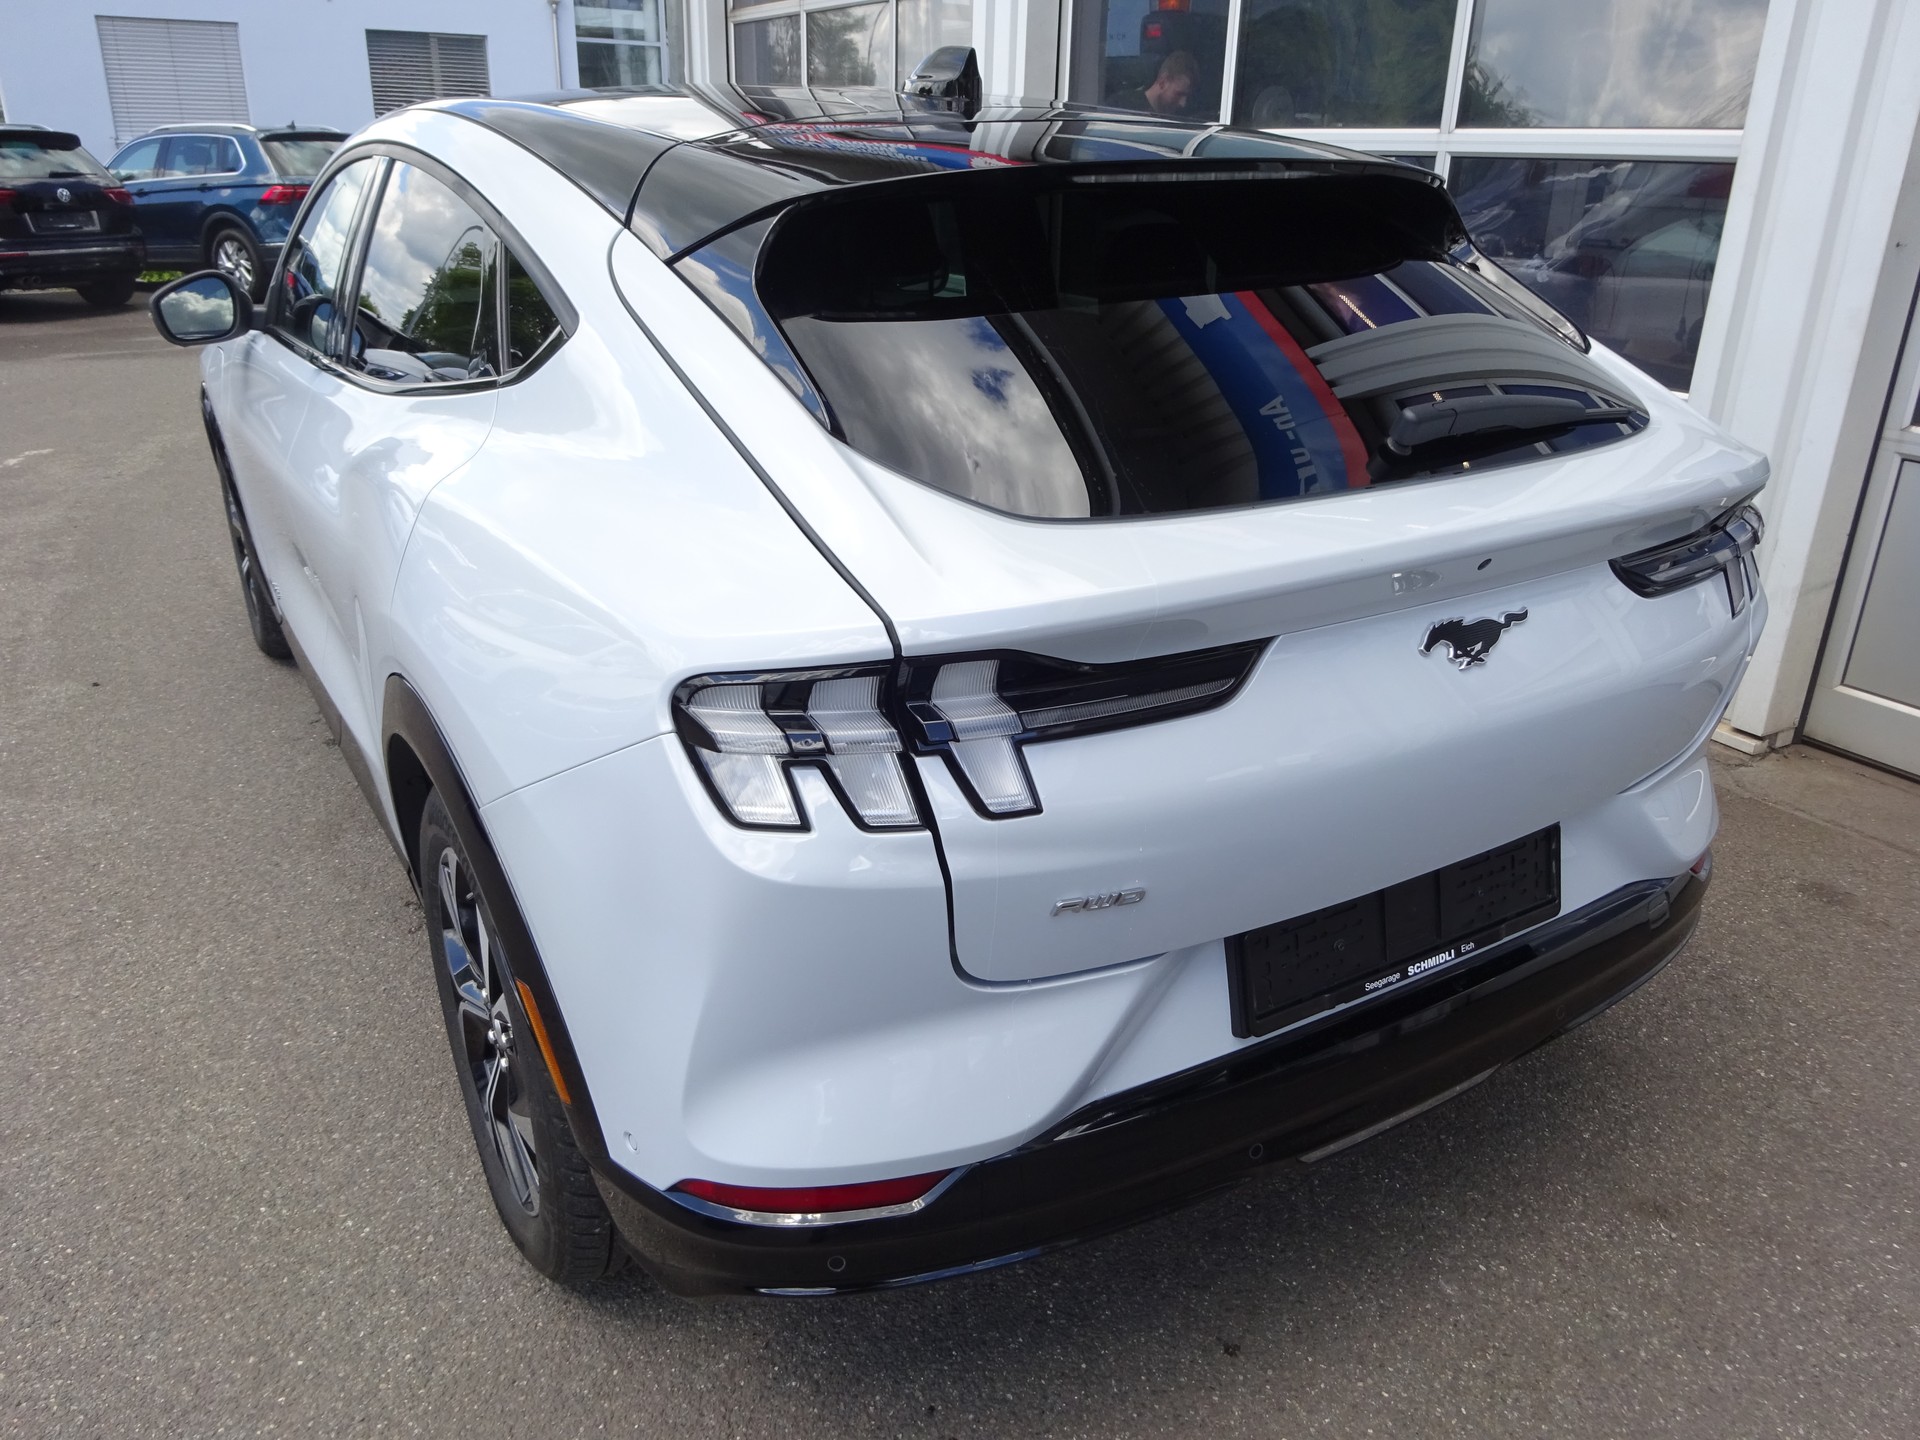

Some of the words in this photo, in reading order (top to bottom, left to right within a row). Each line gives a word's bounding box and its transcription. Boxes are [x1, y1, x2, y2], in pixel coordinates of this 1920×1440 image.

[1050, 887, 1146, 917] AWD
[1364, 972, 1401, 991] Seegarage
[1407, 949, 1455, 976] SCHMIDLI
[1460, 942, 1476, 953] Eich
